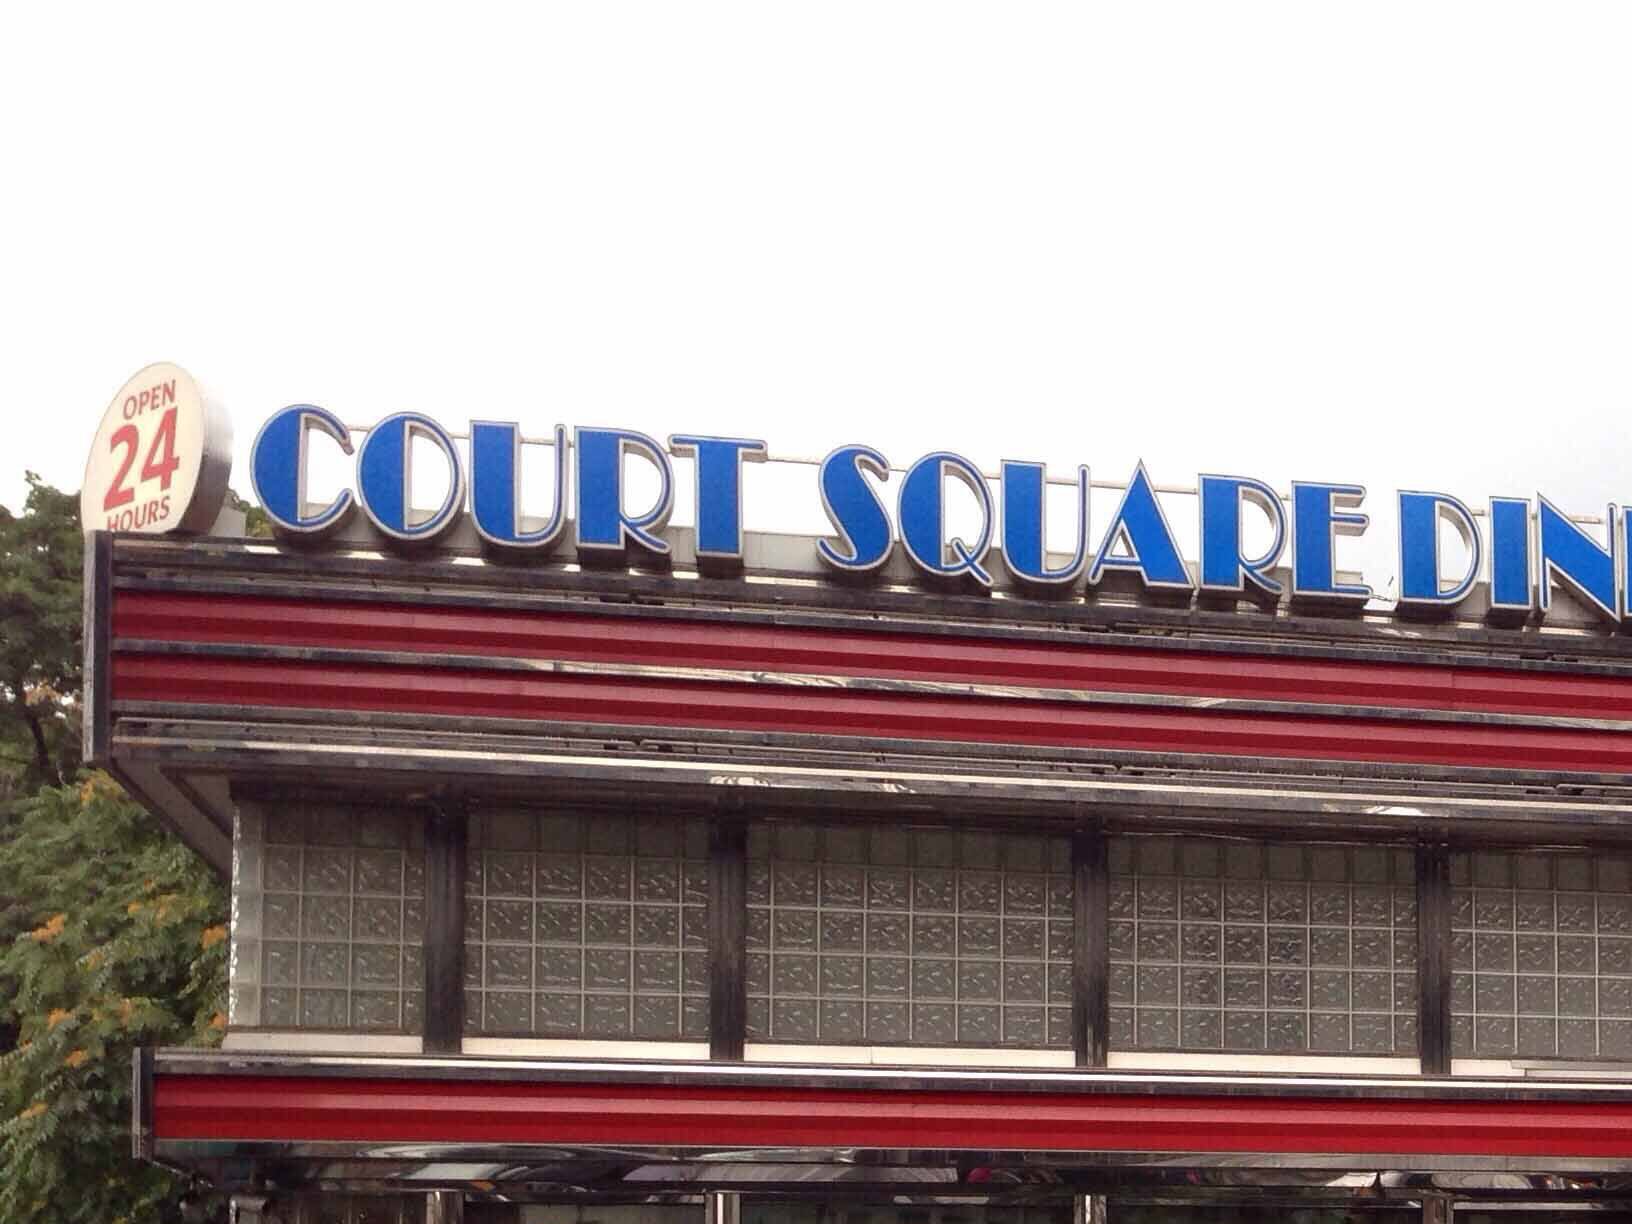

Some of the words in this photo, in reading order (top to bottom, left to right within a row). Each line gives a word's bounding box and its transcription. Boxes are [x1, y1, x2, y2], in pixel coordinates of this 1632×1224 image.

[122, 379, 177, 421] OPEN
[103, 405, 180, 513] 24
[106, 496, 171, 533] HOURS
[250, 404, 768, 560] COURT
[815, 443, 1374, 599] SQUARE
